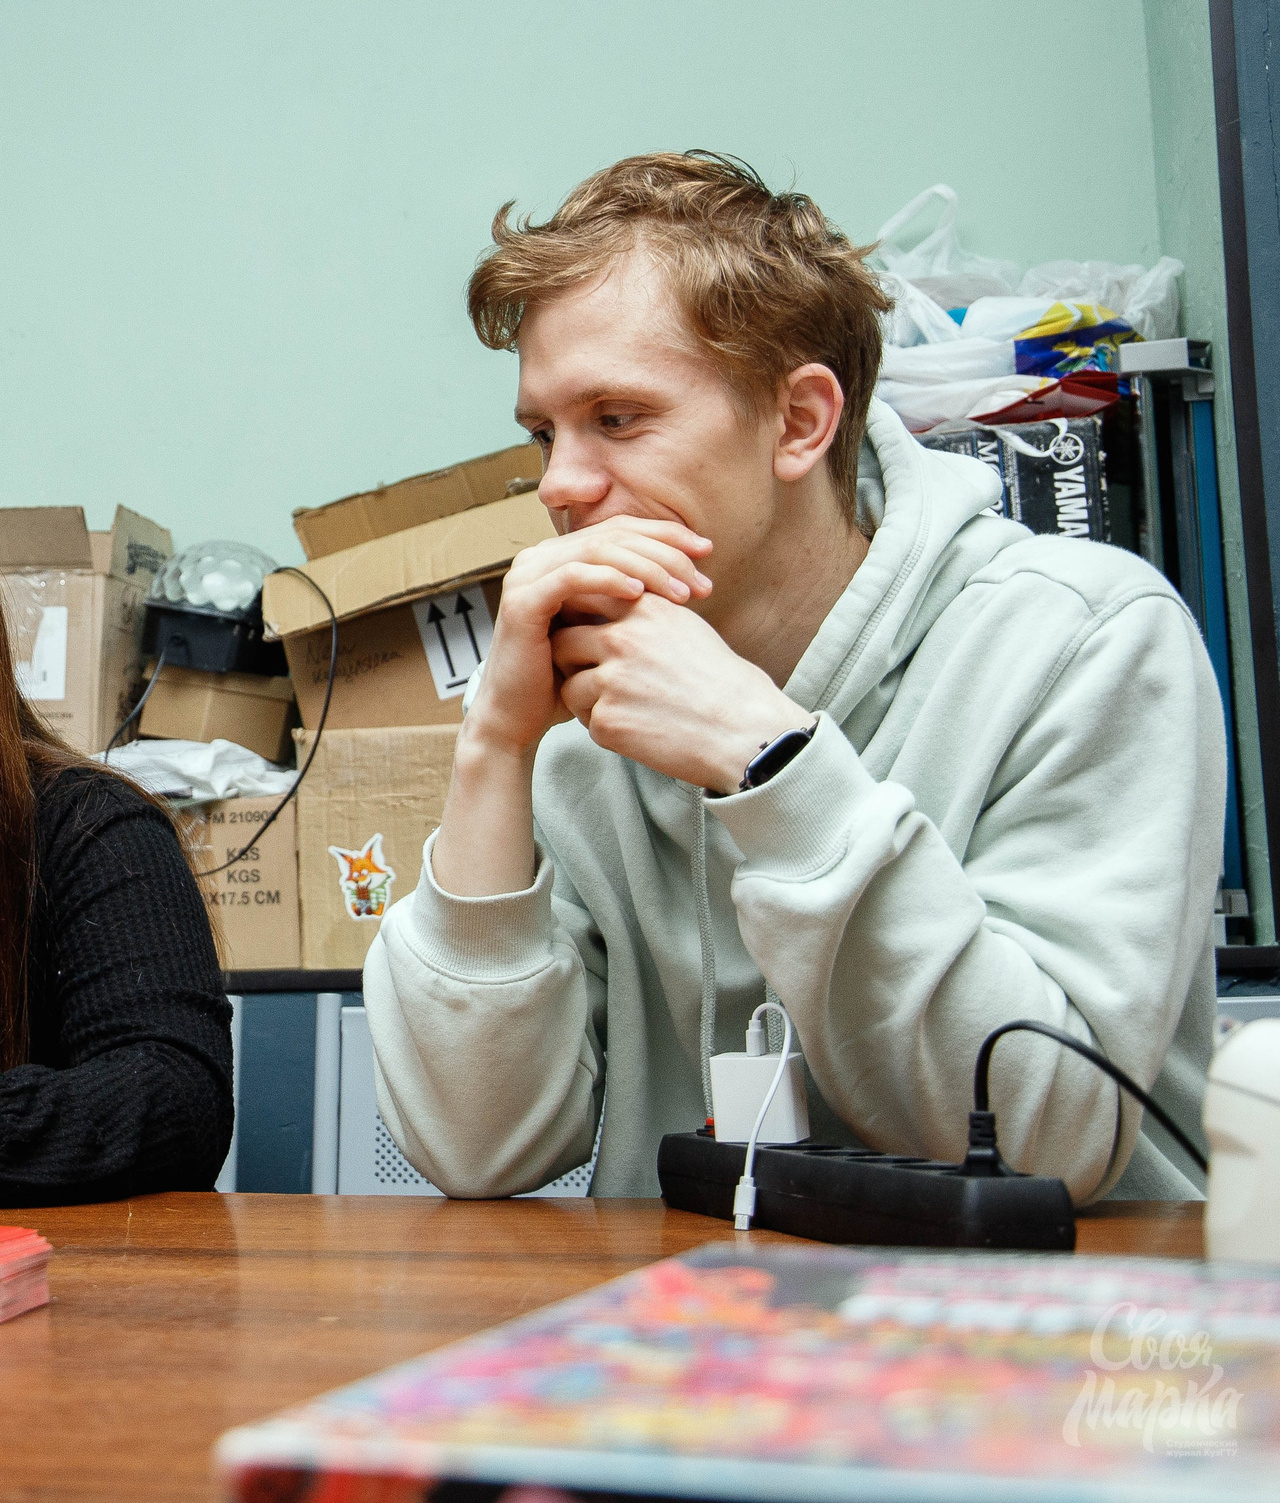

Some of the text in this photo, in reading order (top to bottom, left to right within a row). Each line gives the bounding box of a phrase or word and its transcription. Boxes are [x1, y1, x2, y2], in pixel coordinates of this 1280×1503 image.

[1053, 464, 1091, 541] YAMA
[226, 868, 261, 883] KGS
[254, 889, 281, 905] CM
